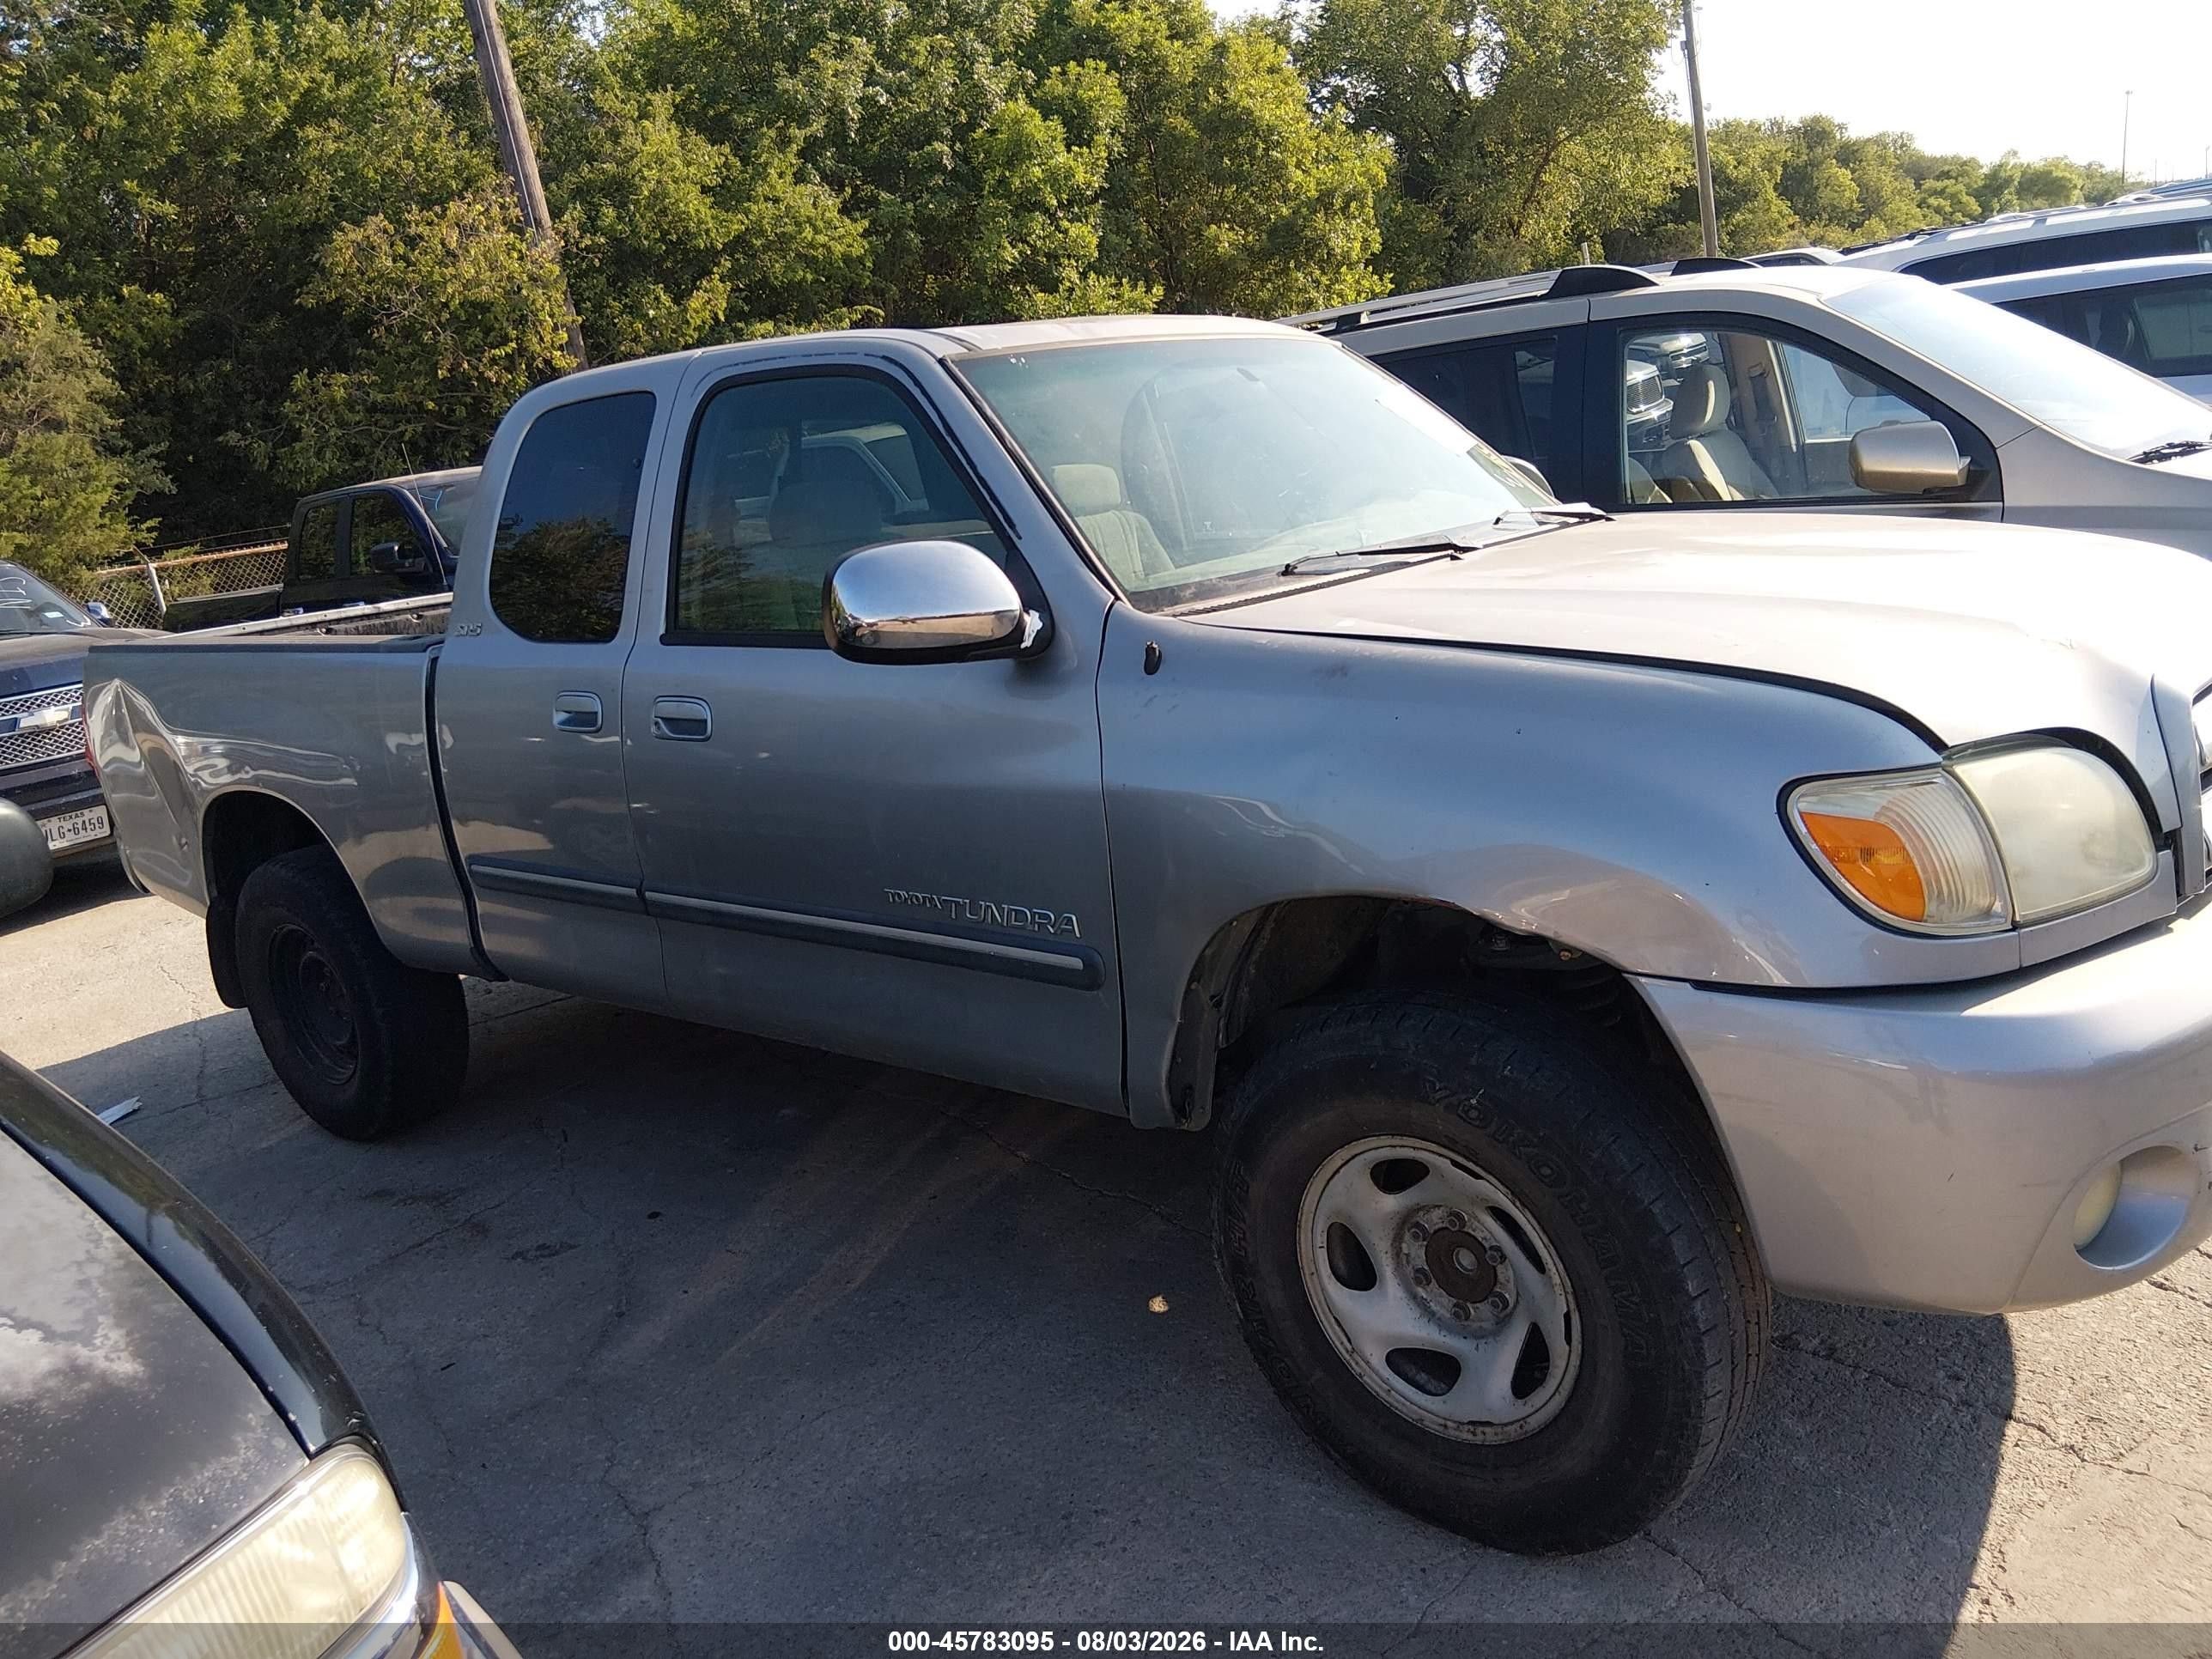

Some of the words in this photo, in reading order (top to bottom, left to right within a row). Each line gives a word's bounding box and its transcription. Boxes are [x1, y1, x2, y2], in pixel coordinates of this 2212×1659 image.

[57, 811, 85, 823] TEXAS
[884, 888, 943, 910] TOYOTA
[941, 896, 1082, 939] TUNDRA
[1420, 1077, 1650, 1360] YOKOHAMA
